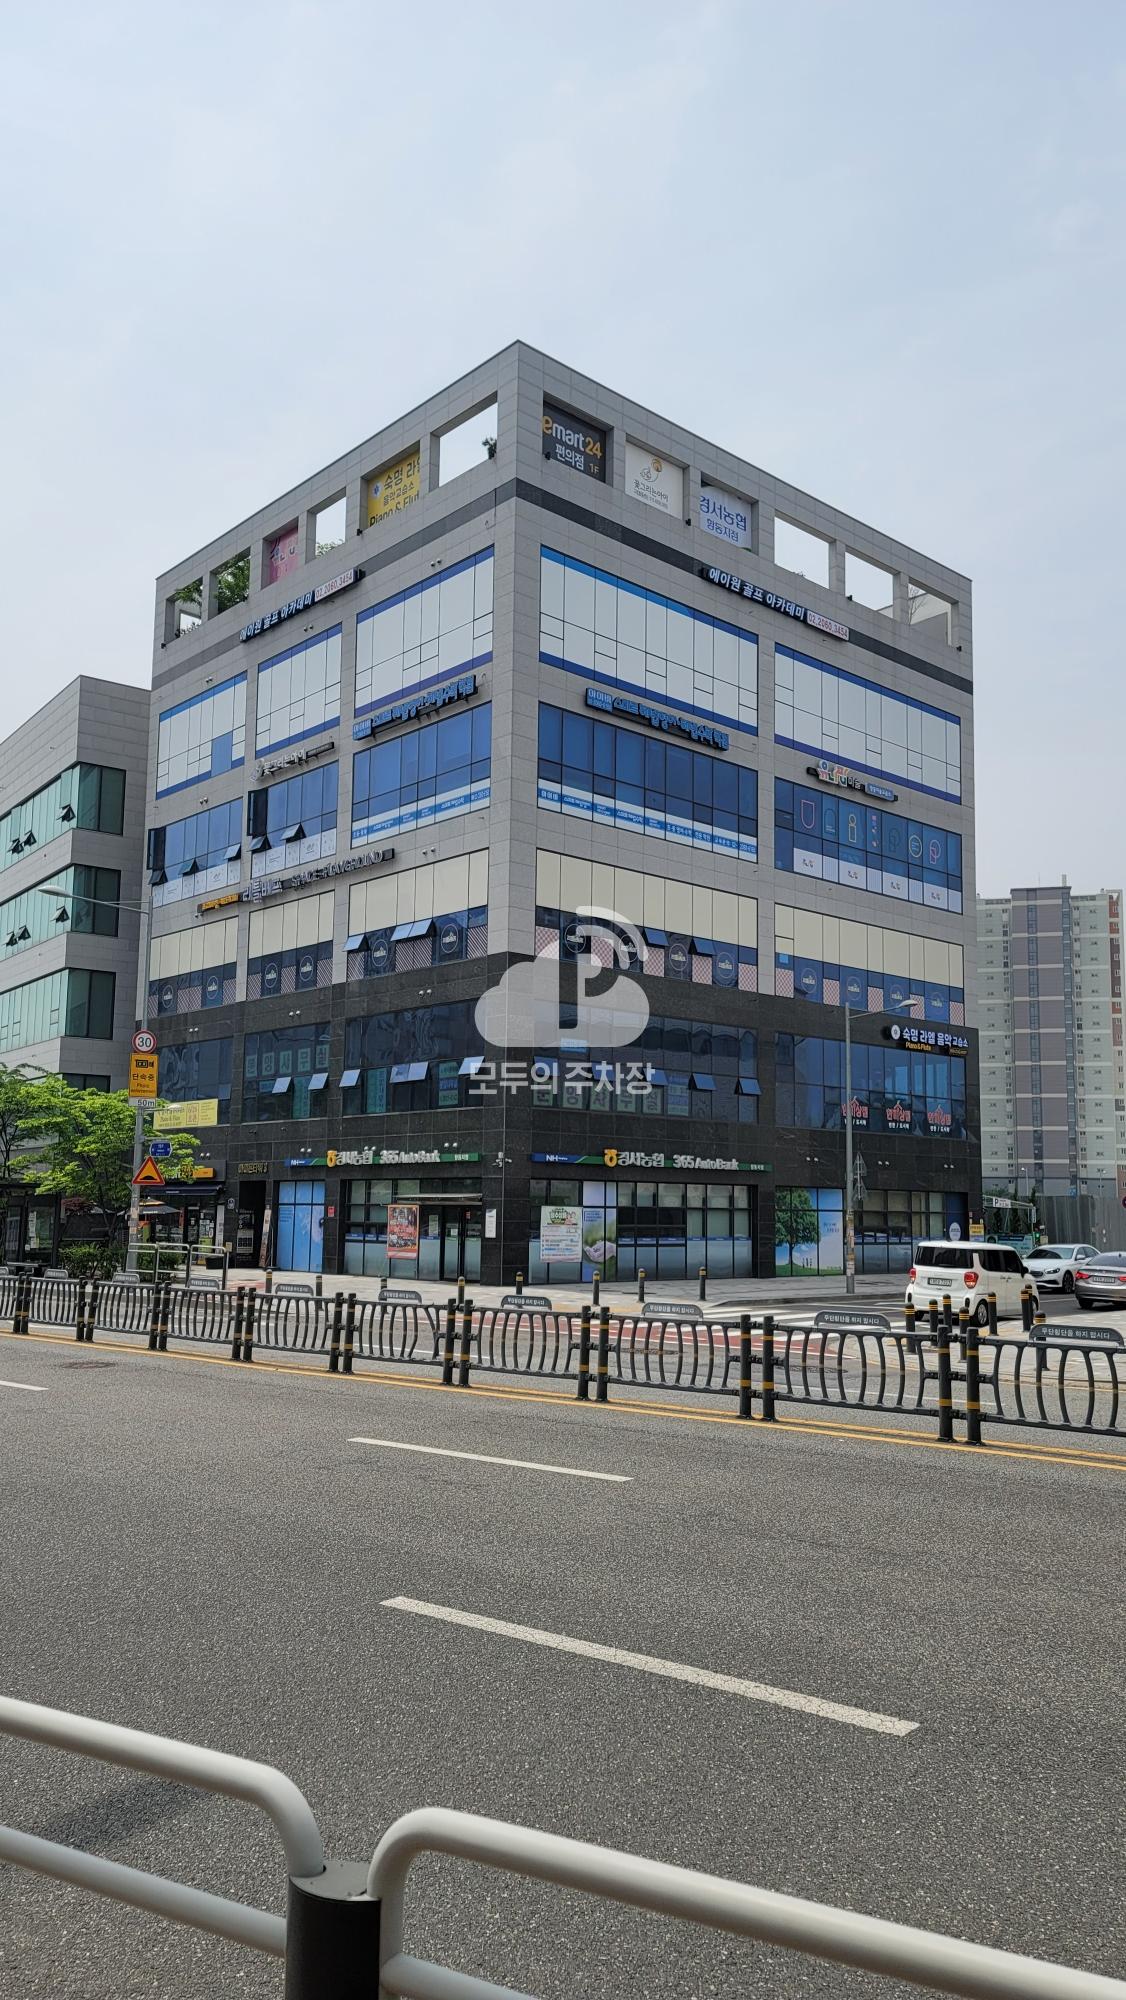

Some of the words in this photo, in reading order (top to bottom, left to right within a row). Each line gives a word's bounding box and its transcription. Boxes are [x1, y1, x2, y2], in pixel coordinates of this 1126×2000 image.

[541, 416, 602, 458] emart24
[556, 444, 584, 471] 편의점
[589, 463, 600, 475] 1F
[384, 467, 404, 491] 숙명
[700, 496, 747, 531] 경서농협
[709, 567, 741, 593] 에이원
[743, 582, 763, 602] 골프
[766, 594, 805, 621] 아카데미
[240, 620, 263, 641] 에이원
[263, 609, 279, 630] 골프
[280, 591, 313, 618] 아카데미
[137, 1037, 151, 1048] 30
[902, 1027, 918, 1042] 숙명
[920, 1030, 935, 1045] 라엘
[132, 1073, 155, 1082] 단속중
[137, 1099, 155, 1107] 50m
[379, 1150, 400, 1165] 365
[400, 1150, 441, 1164] AutoBank
[546, 1154, 558, 1162] NH
[618, 1151, 665, 1168] 경서농협
[672, 1154, 695, 1169] 365
[694, 1156, 739, 1171] AutoBank
[824, 1315, 850, 1323] 무단횡단을
[851, 1316, 862, 1324] 하지
[1041, 1327, 1074, 1338] 무단횡단을
[1075, 1329, 1089, 1338] 하지
